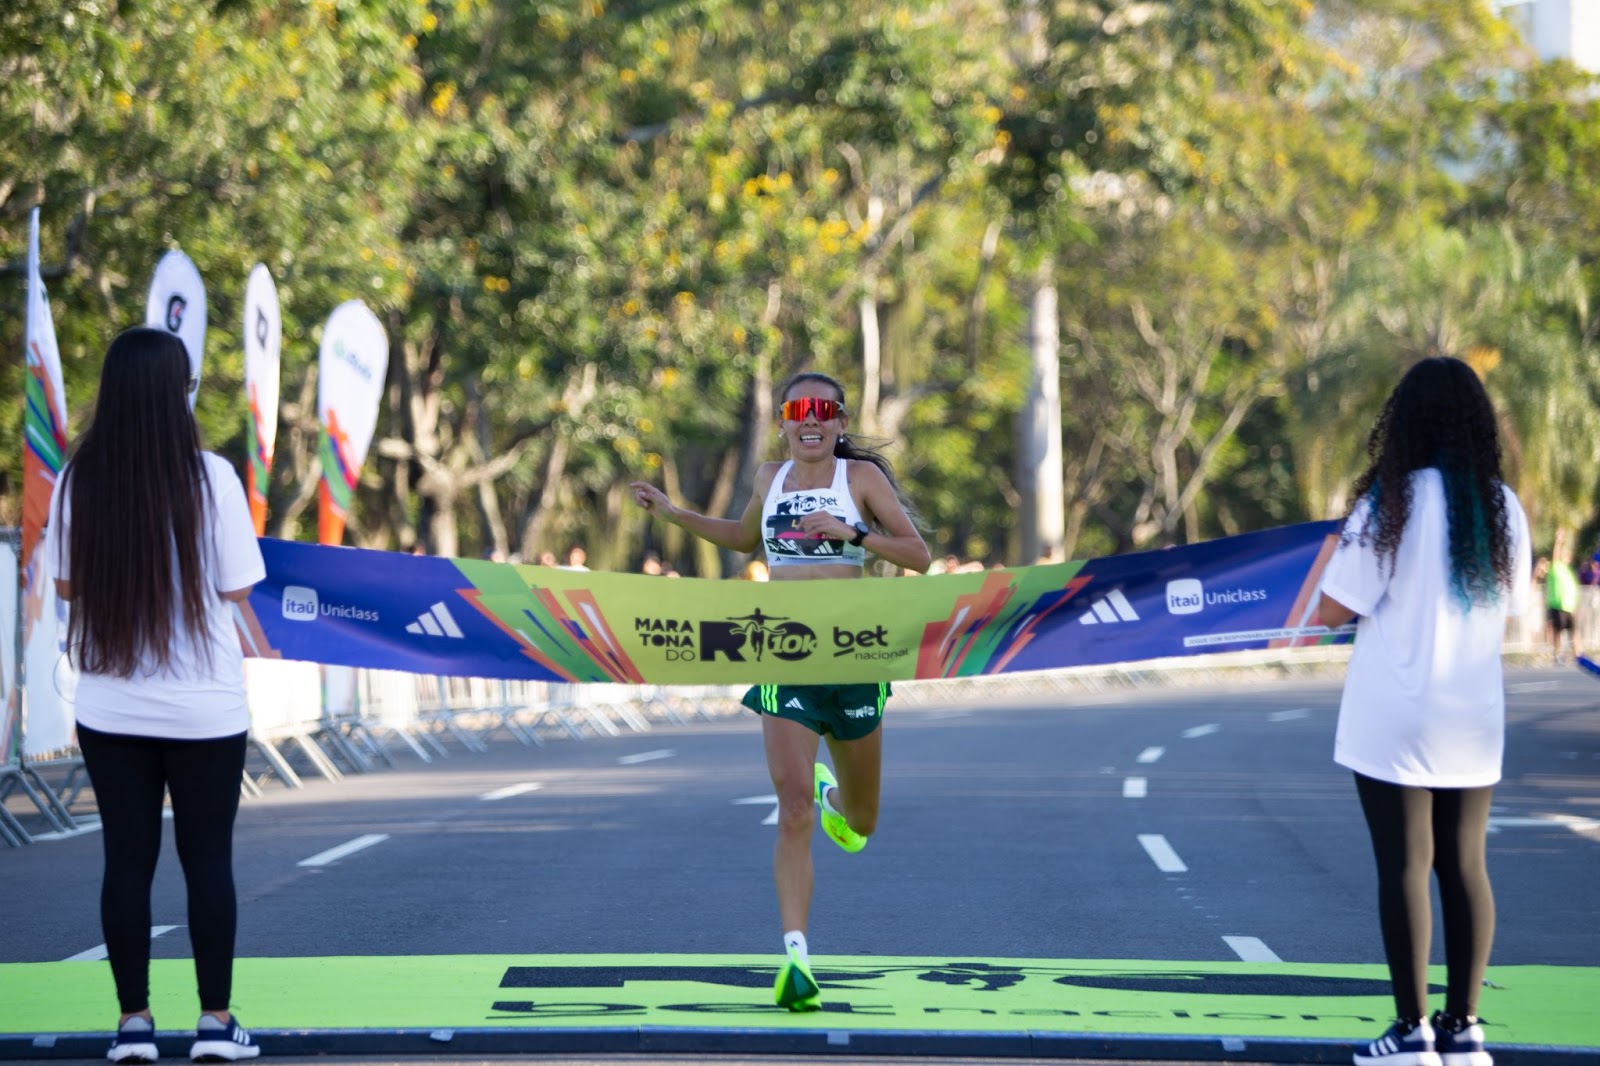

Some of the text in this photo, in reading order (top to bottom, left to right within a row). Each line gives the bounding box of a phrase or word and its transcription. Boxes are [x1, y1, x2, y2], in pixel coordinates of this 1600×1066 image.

[819, 496, 838, 506] bet
[1170, 588, 1267, 608] itaú Uniclass
[285, 598, 379, 622] itaú Uniclass
[635, 617, 694, 633] MARA
[639, 633, 694, 648] TONA
[771, 634, 817, 654] 10K
[832, 625, 888, 648] bet
[1210, 635, 1222, 643] COM
[665, 650, 695, 662] DO
[855, 647, 910, 660] nacional
